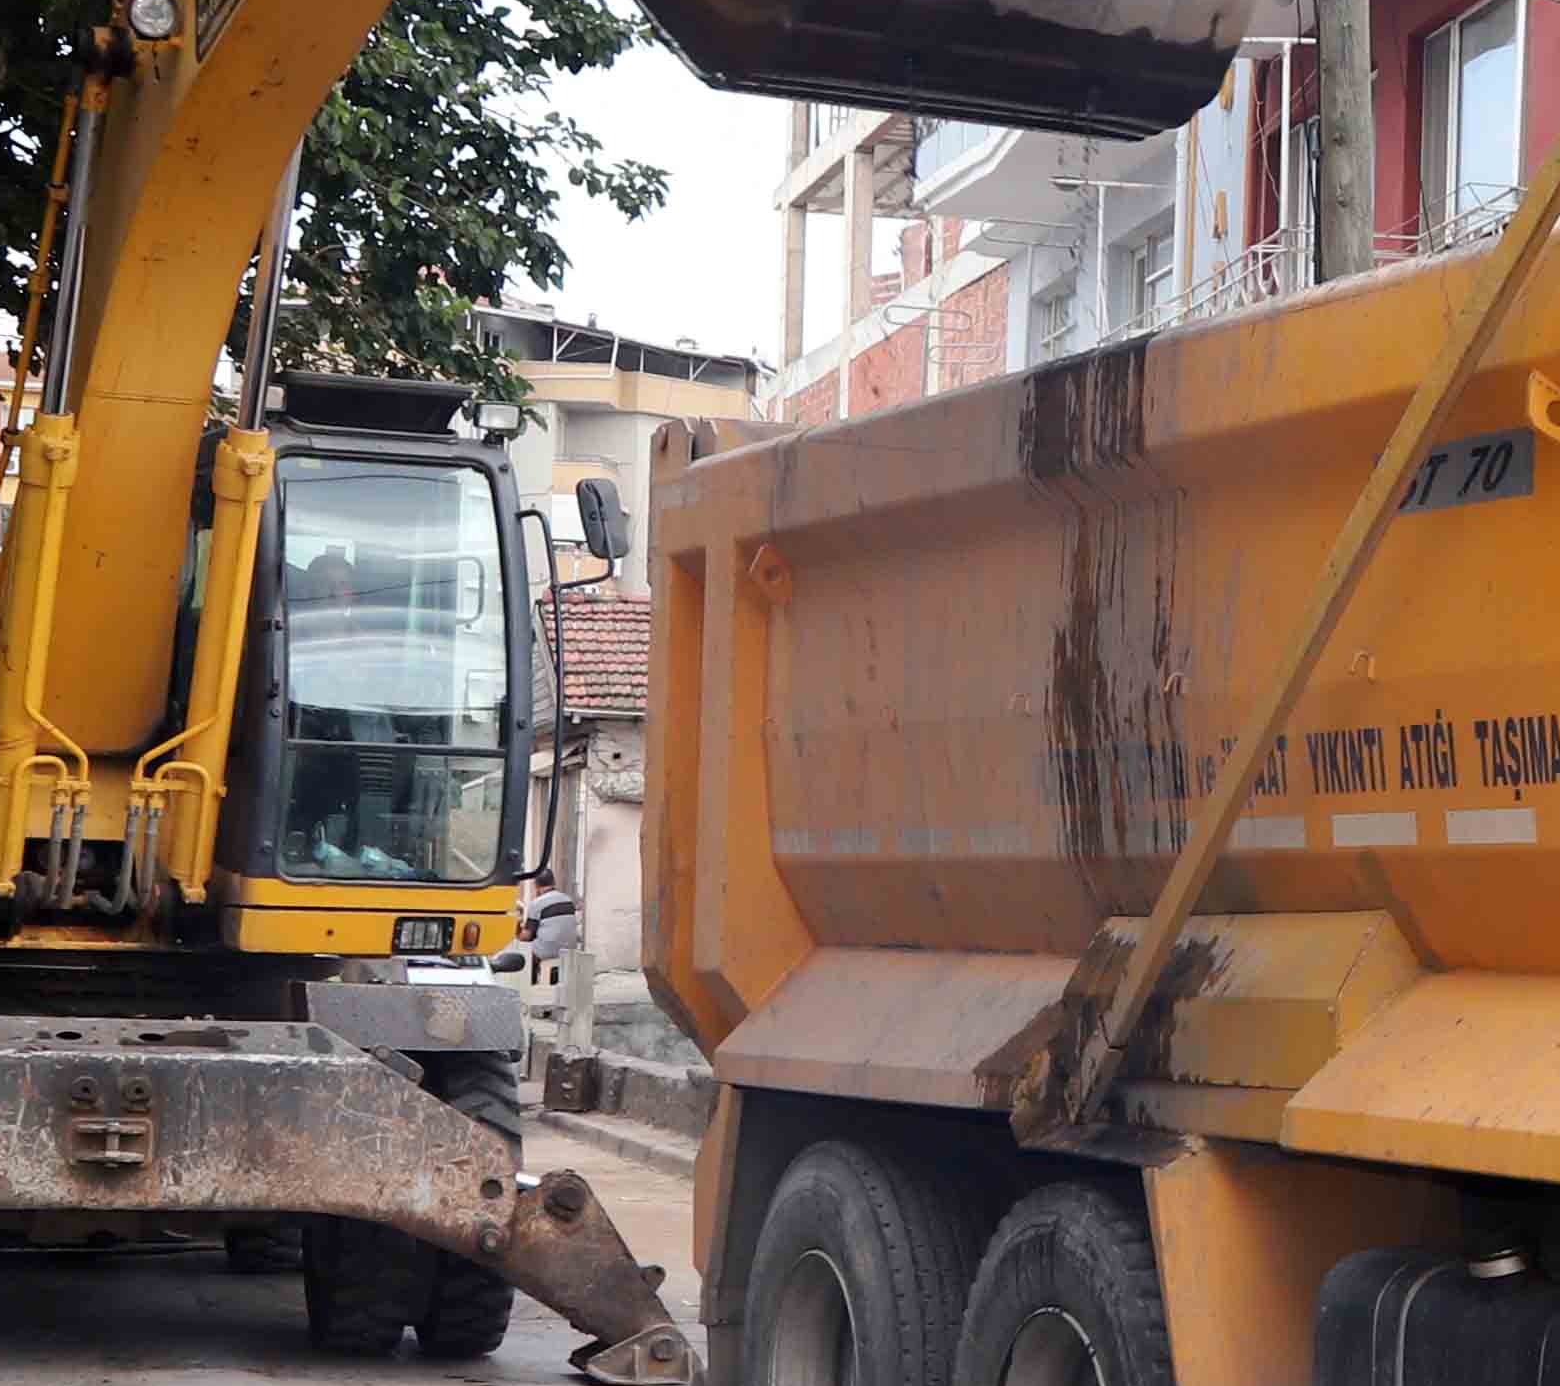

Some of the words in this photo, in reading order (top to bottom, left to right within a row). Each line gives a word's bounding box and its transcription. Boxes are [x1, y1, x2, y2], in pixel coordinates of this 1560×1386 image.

[1458, 440, 1513, 497] 70
[1306, 728, 1387, 795] YIKINTI
[1400, 709, 1458, 791] ATIĞI
